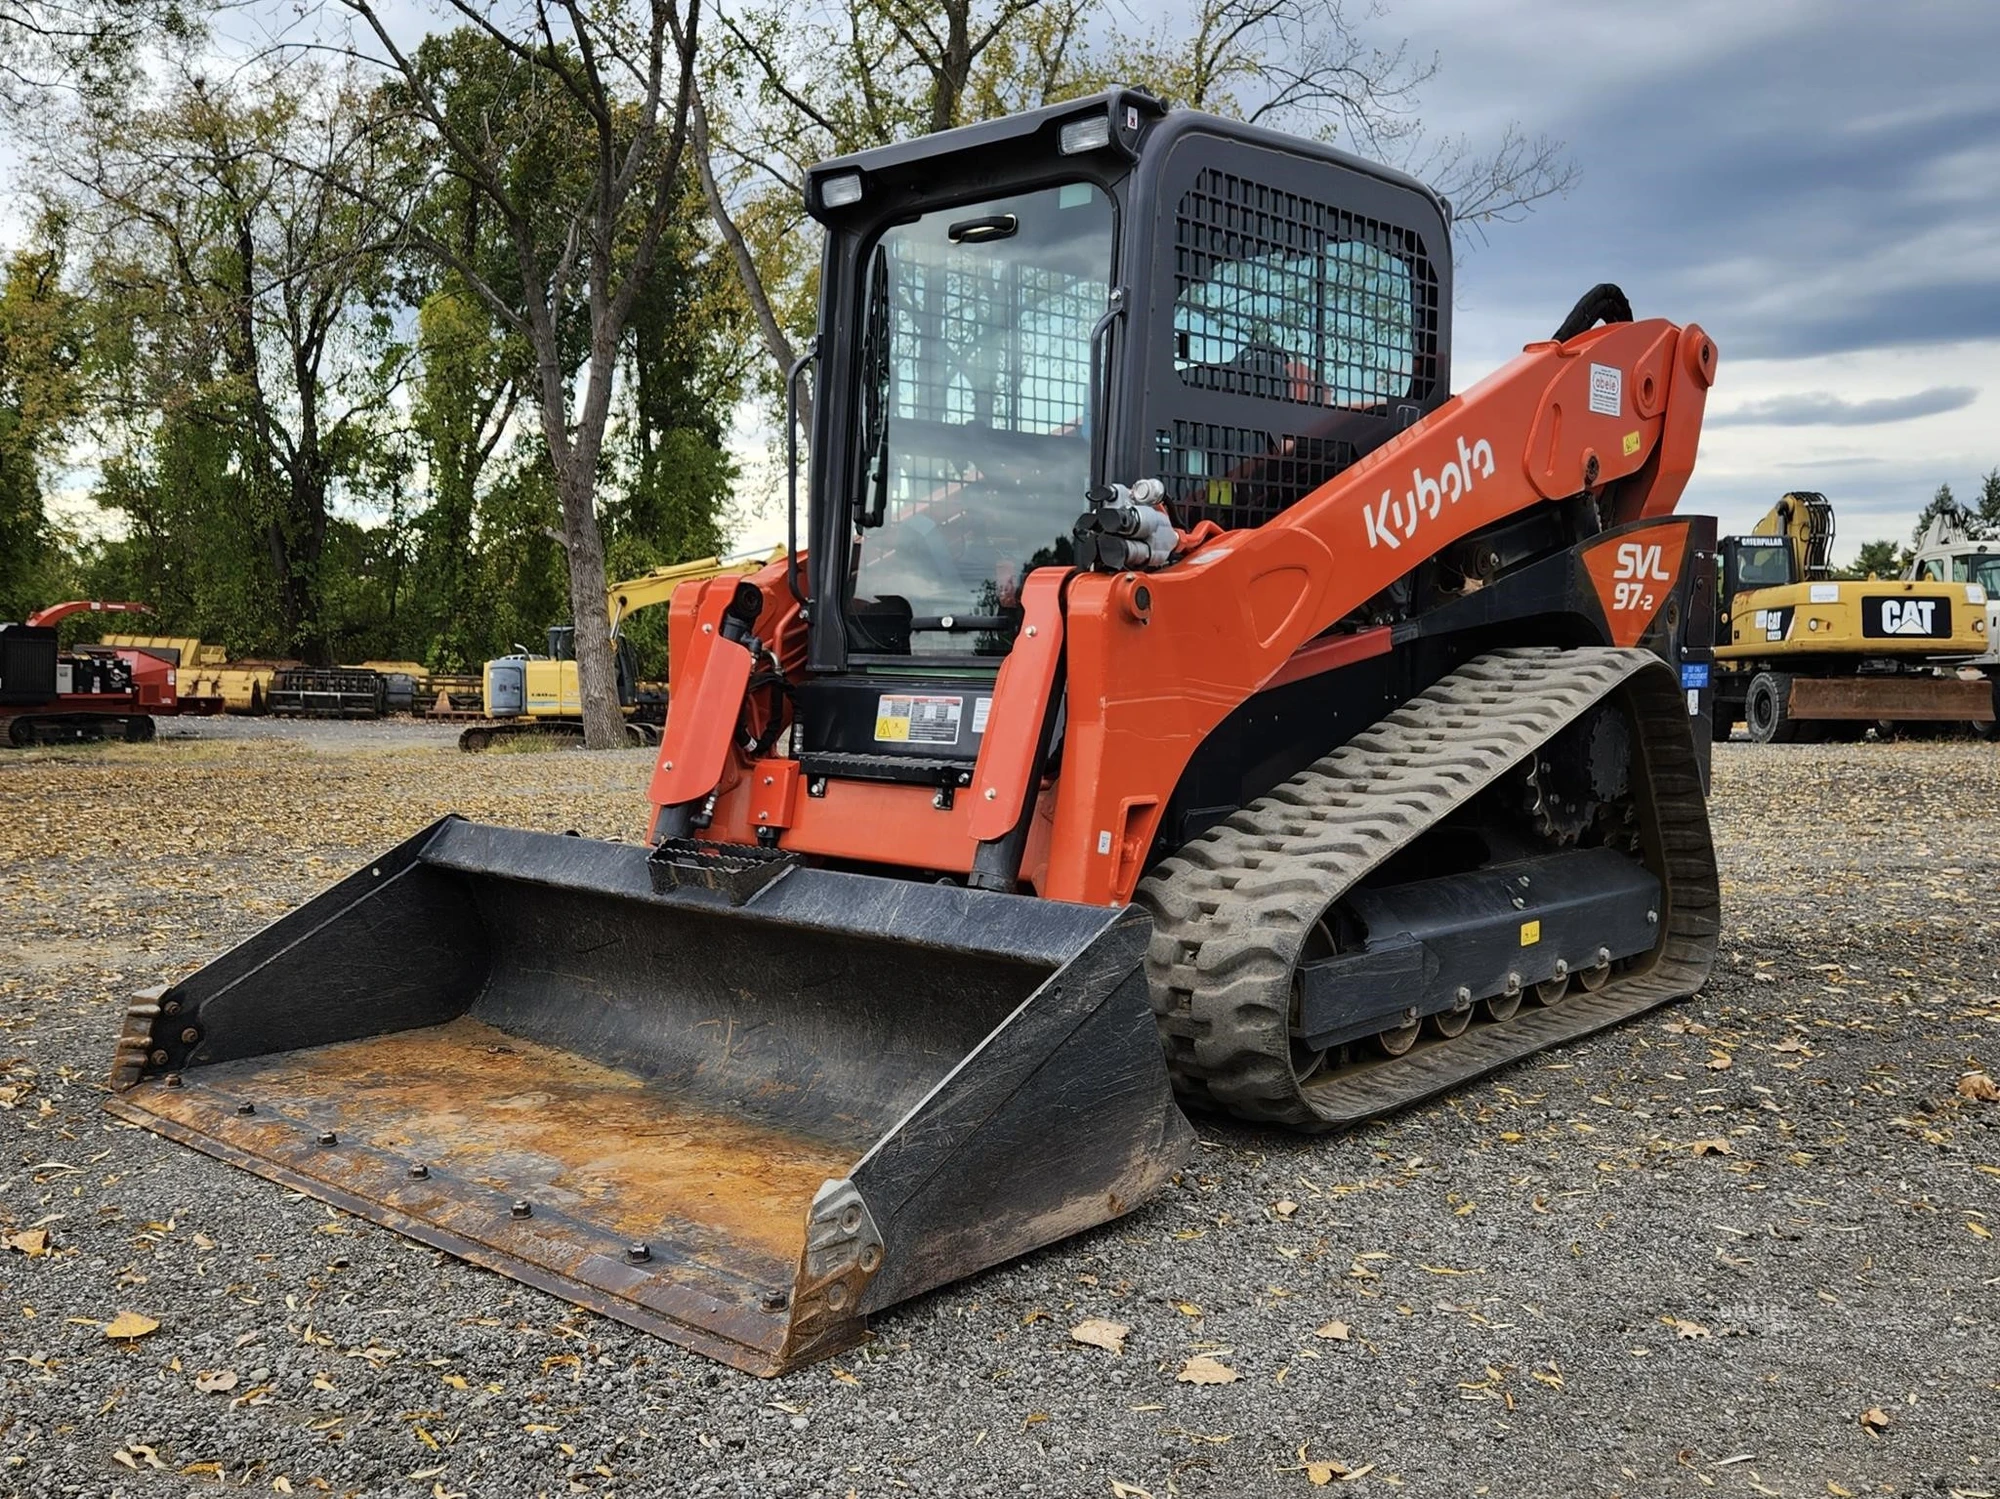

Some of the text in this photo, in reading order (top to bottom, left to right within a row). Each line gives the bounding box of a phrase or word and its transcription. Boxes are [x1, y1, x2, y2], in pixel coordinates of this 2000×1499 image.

[1363, 436, 1495, 549] Kubota
[1741, 537, 1783, 546] CATERPILLAR
[1613, 543, 1670, 581] SVL
[1767, 611, 1782, 630] CAT
[1881, 600, 1936, 635] CAT
